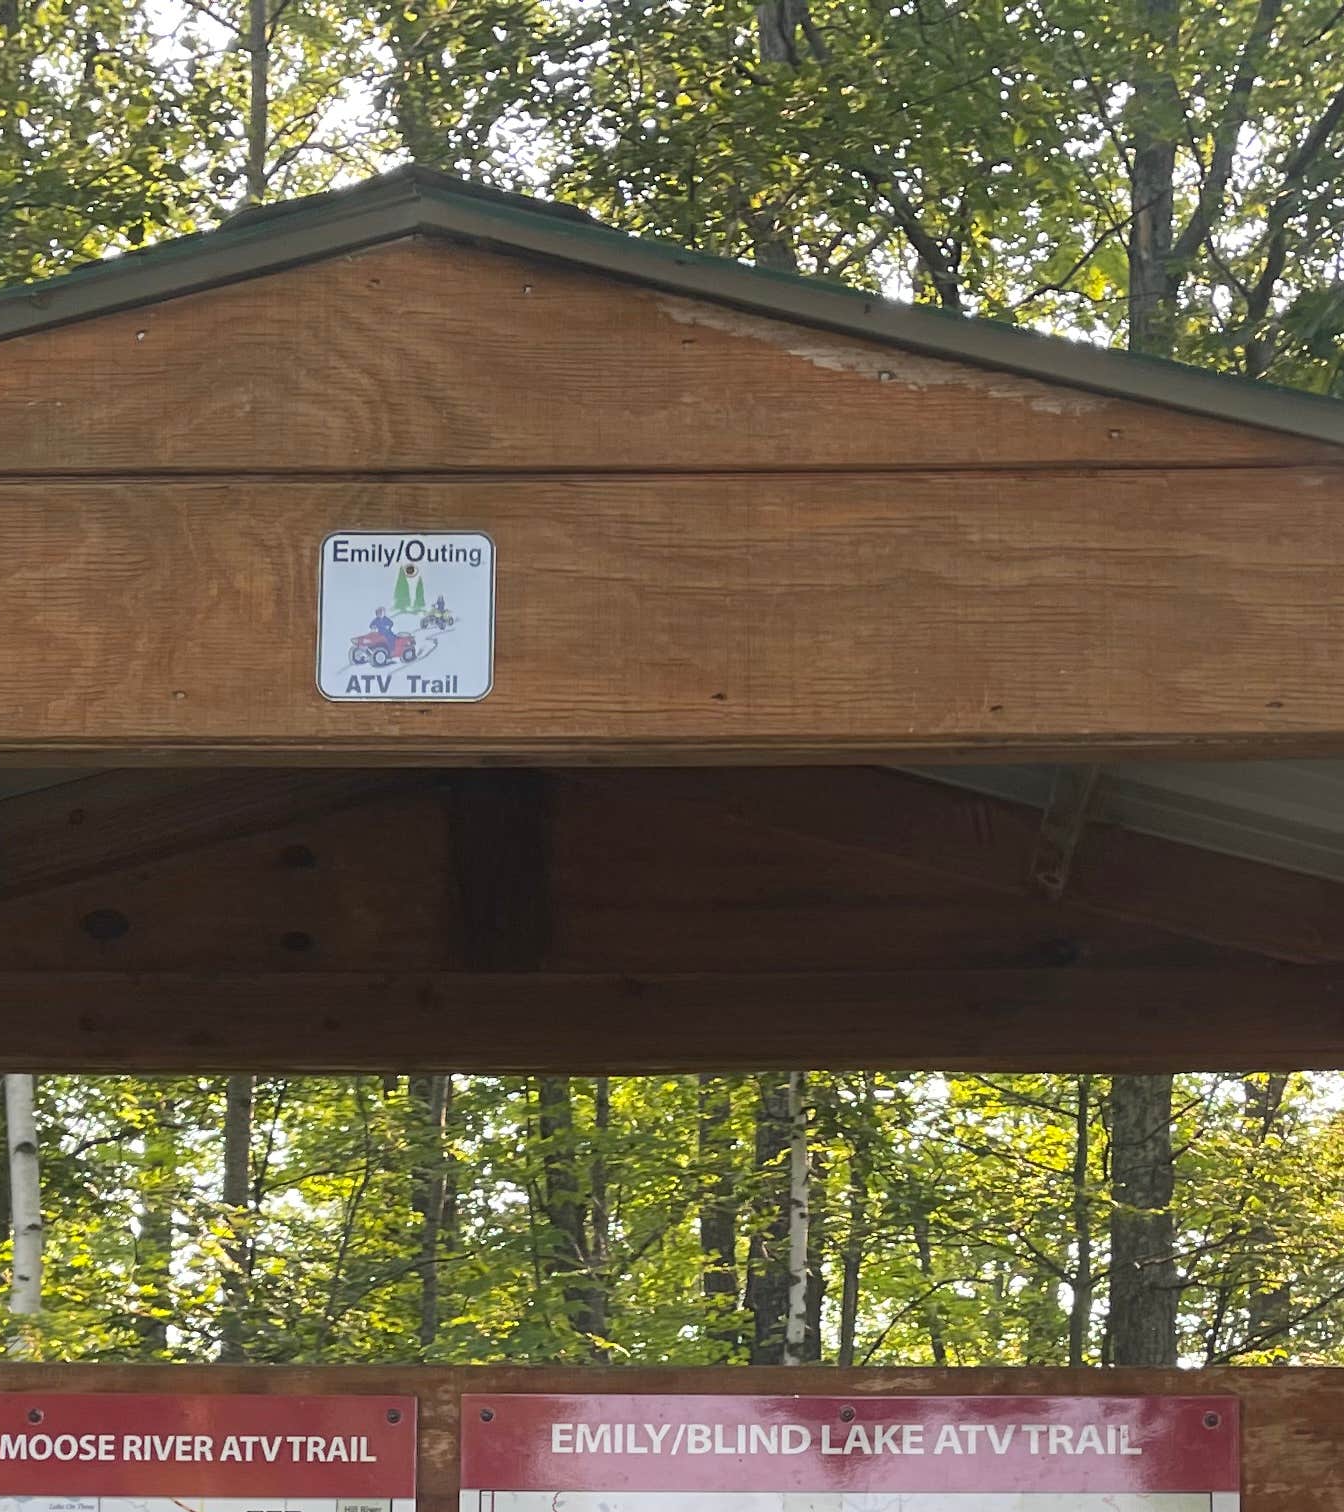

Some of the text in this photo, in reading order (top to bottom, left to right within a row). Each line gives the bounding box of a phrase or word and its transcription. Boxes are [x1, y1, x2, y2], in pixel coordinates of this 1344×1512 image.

[333, 540, 482, 567] Emily/Outing
[346, 675, 458, 694] ATV Trail
[123, 1435, 214, 1462] RIVER
[220, 1436, 281, 1462] ATV
[287, 1436, 376, 1462] TRAIL
[552, 1424, 1142, 1455] EMILY/BLIND LAKE ATV TRAIL
